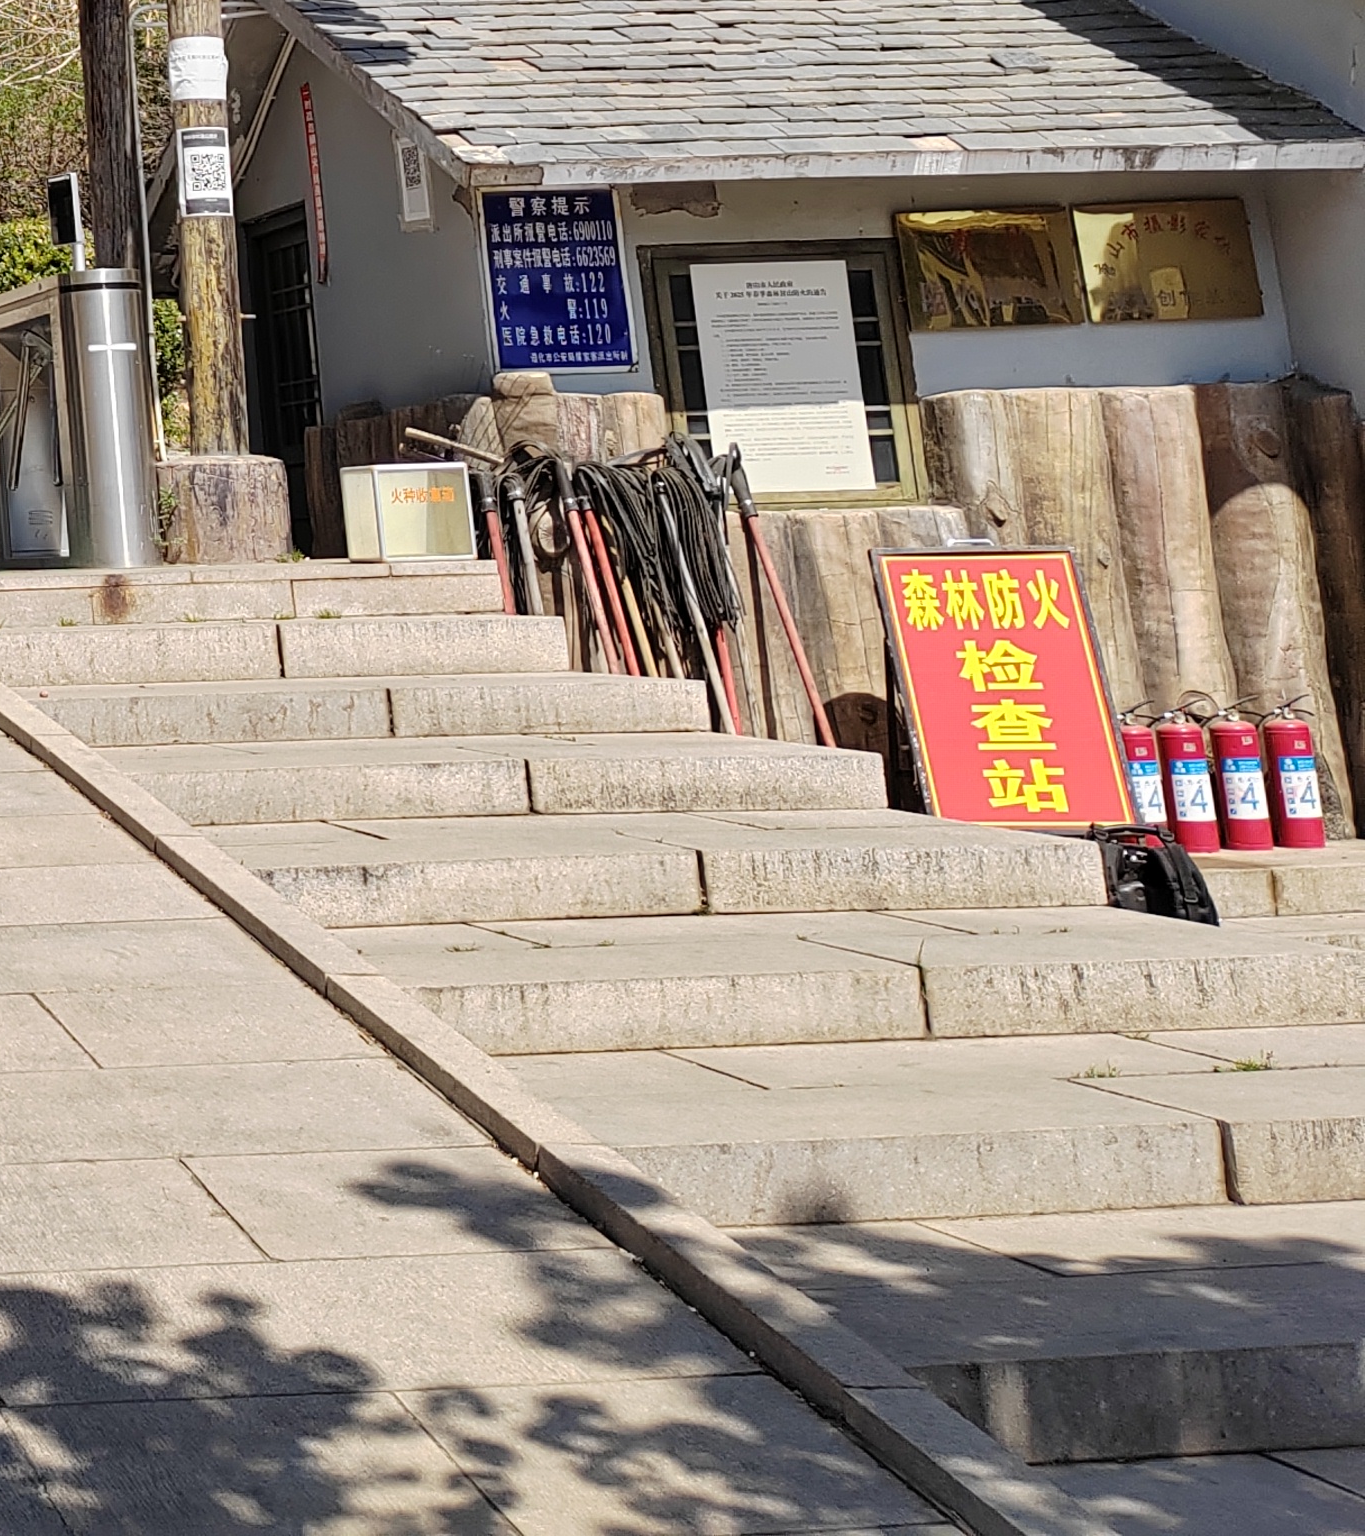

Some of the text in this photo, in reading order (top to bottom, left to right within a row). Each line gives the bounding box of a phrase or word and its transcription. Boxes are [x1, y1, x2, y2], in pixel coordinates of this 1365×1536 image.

[509, 196, 591, 217] 警察提示
[900, 569, 1070, 631] 森林防火
